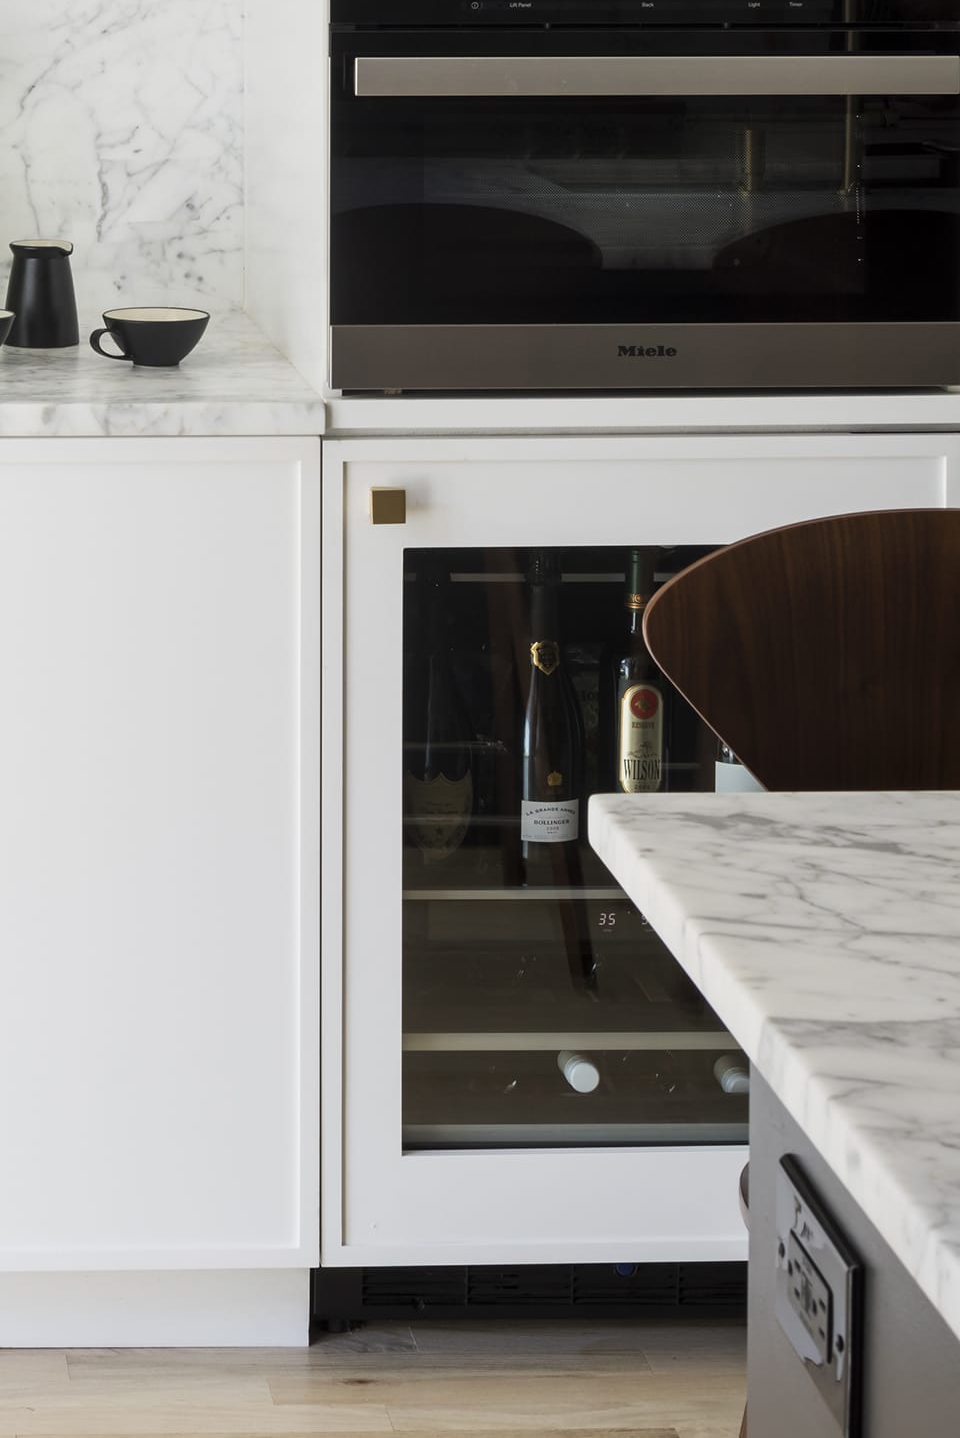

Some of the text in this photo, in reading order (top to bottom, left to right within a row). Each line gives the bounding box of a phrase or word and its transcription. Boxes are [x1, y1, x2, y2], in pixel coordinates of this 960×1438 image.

[617, 346, 677, 357] Miele
[624, 759, 660, 780] WILSON
[599, 913, 616, 925] 35
